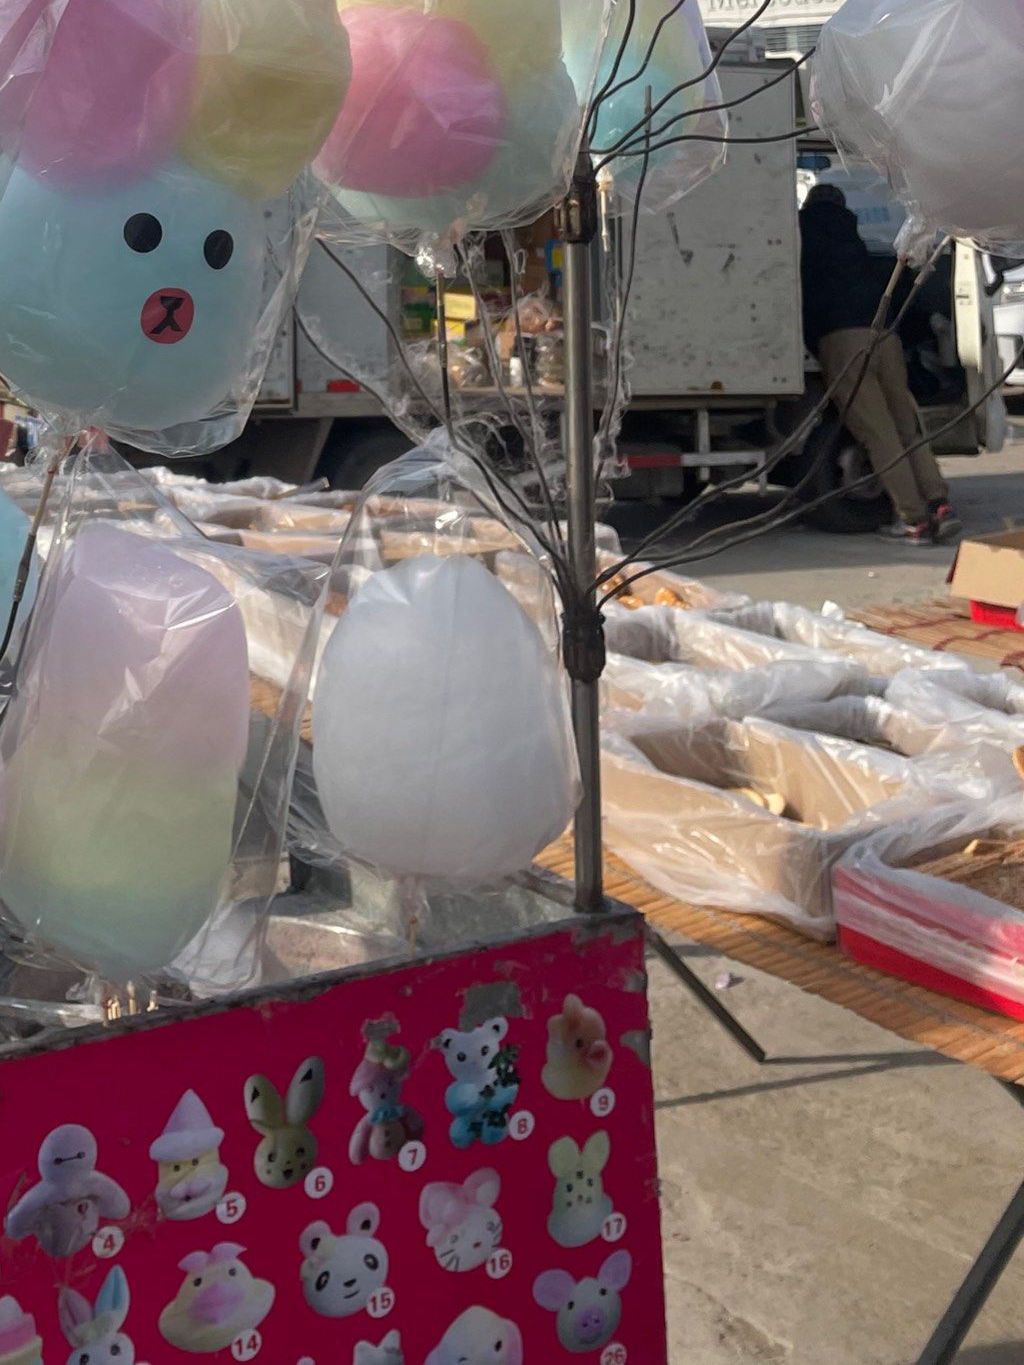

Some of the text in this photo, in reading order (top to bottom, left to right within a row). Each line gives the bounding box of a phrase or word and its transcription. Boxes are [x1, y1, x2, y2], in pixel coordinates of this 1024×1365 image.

[597, 1094, 609, 1112] 9
[516, 1118, 528, 1134] 8
[407, 1148, 419, 1166] 7
[314, 1174, 326, 1193] 6
[226, 1199, 239, 1218] 5
[604, 1217, 624, 1237] 17
[102, 1234, 115, 1251] 4
[489, 1253, 510, 1273] 16
[369, 1292, 392, 1313] 15
[234, 1334, 259, 1356] 14
